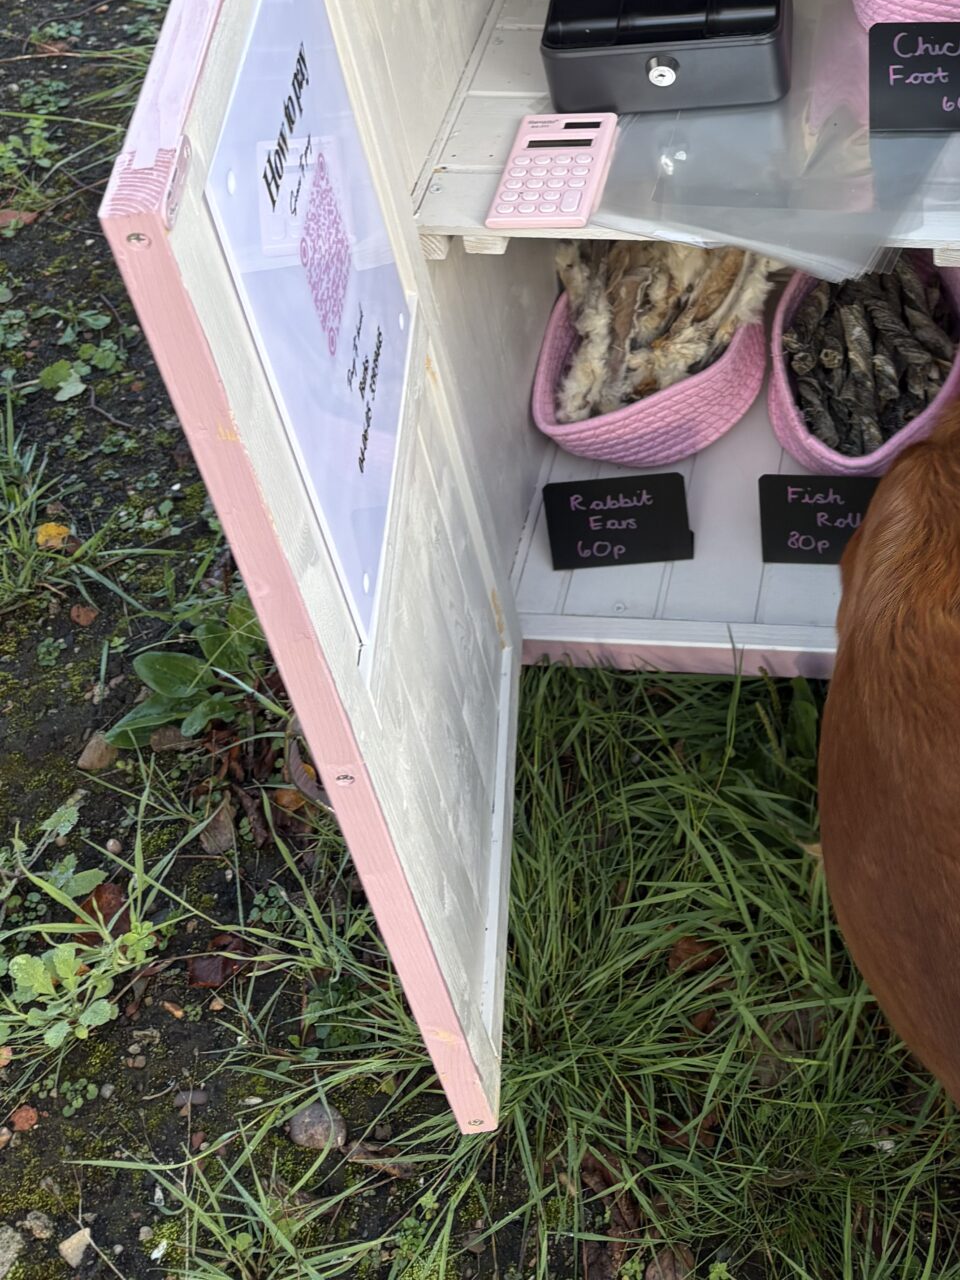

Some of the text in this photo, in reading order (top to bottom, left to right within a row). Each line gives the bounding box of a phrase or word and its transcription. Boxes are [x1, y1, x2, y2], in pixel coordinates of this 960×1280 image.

[889, 65, 949, 86] Foot
[262, 41, 309, 212] How to pay
[569, 490, 653, 511] Rabbit
[787, 486, 845, 505] Fish
[589, 516, 637, 530] Ears
[816, 512, 862, 528] Roll
[577, 541, 626, 559] 60p
[787, 531, 830, 554] 80p
